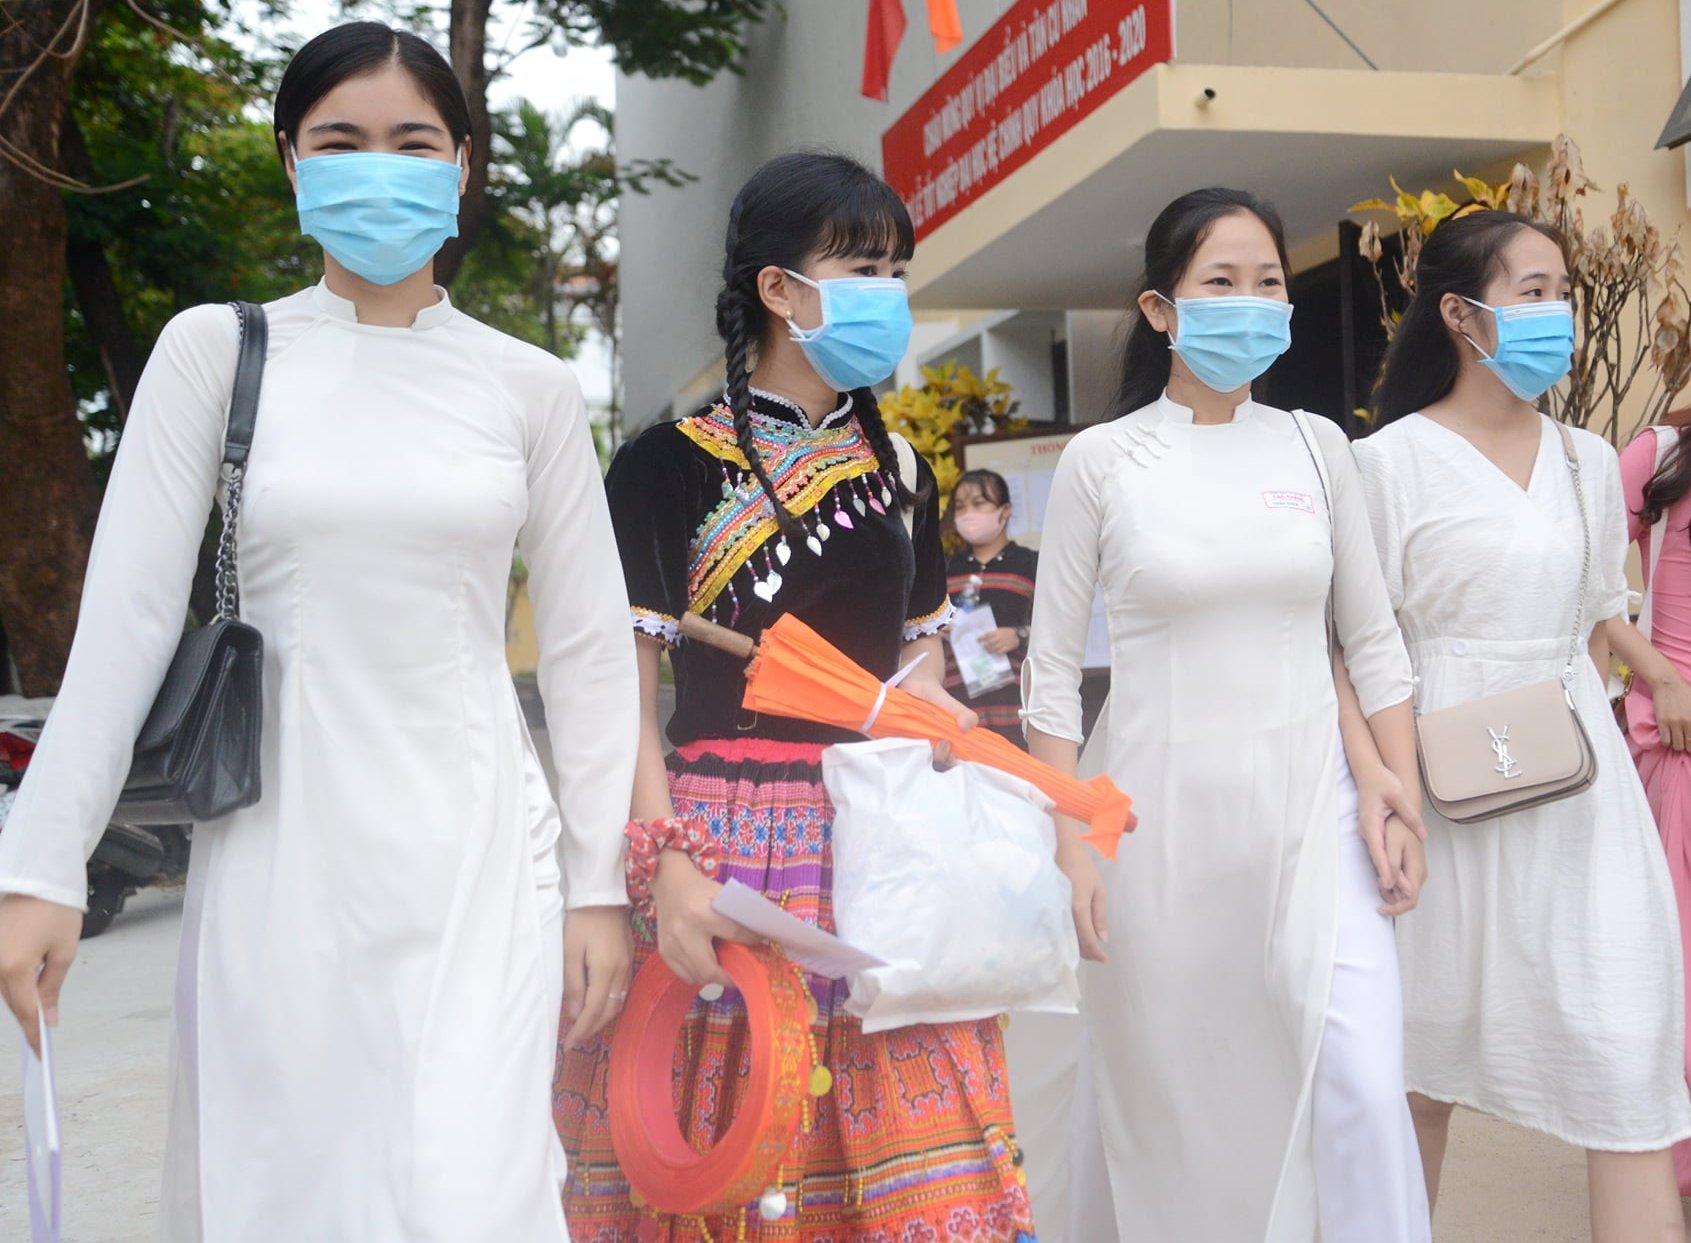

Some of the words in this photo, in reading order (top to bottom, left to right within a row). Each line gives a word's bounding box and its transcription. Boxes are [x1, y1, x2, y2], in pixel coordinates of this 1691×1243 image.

[1022, 90, 1040, 148] QUY
[1063, 53, 1086, 112] HỌC
[1085, 31, 1112, 93] 2016
[1118, 3, 1146, 67] 2020
